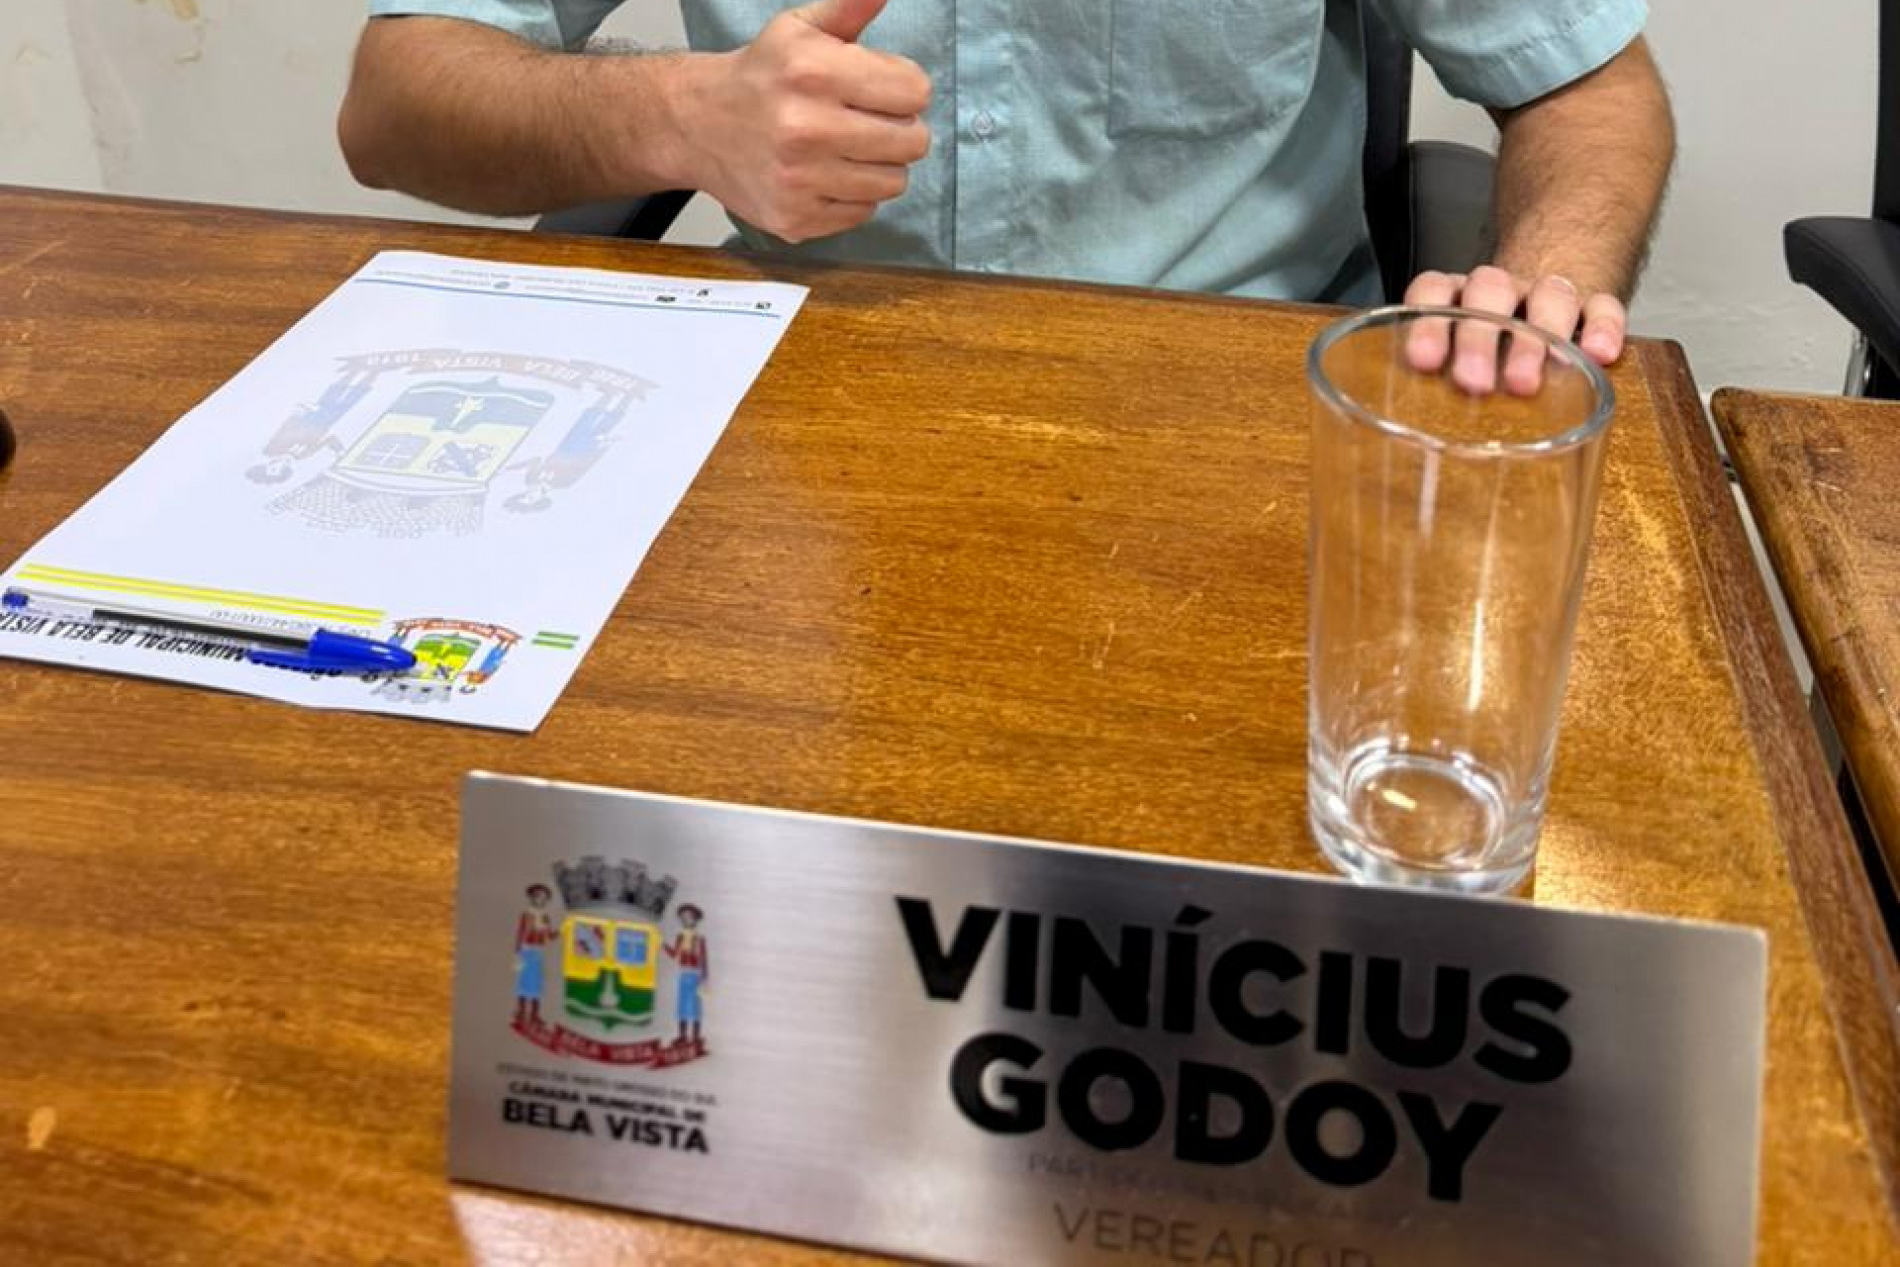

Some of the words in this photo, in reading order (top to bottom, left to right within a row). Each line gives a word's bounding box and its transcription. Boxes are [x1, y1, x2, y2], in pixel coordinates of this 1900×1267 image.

[895, 896, 1574, 1084] VINÍCIUS
[503, 1097, 592, 1135] BELA
[605, 1112, 710, 1154] VISTA
[949, 1031, 1504, 1202] GODOY
